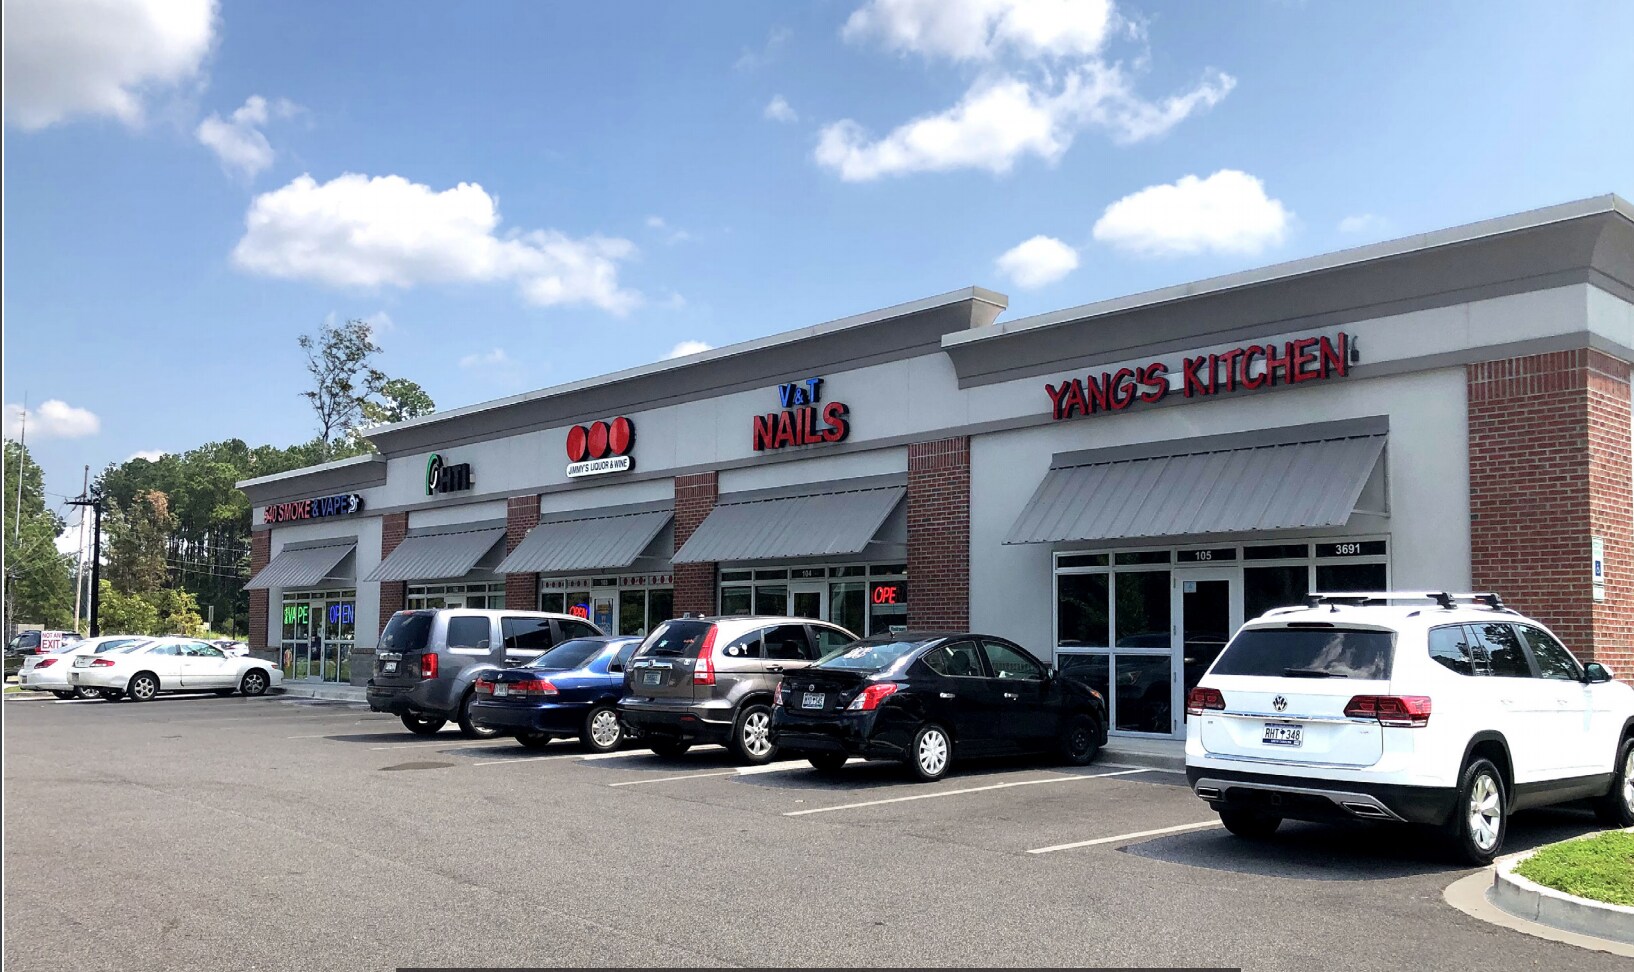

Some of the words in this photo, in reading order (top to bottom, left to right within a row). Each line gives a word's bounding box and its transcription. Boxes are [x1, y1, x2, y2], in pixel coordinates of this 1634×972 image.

[1045, 362, 1169, 420] YANG'S
[1183, 332, 1349, 398] KITCHEN
[753, 401, 850, 451] NAILS
[569, 464, 589, 475] JIMMY'S
[590, 461, 609, 471] LIQUOR
[614, 458, 628, 469] WINE
[278, 500, 310, 522] SMOKE
[312, 500, 319, 518] &
[320, 495, 347, 516] VAPE
[1195, 550, 1212, 560] 105
[1335, 543, 1360, 554] 3691
[329, 604, 354, 624] OPEN
[42, 640, 60, 649] EXIT
[1286, 729, 1300, 740] 348
